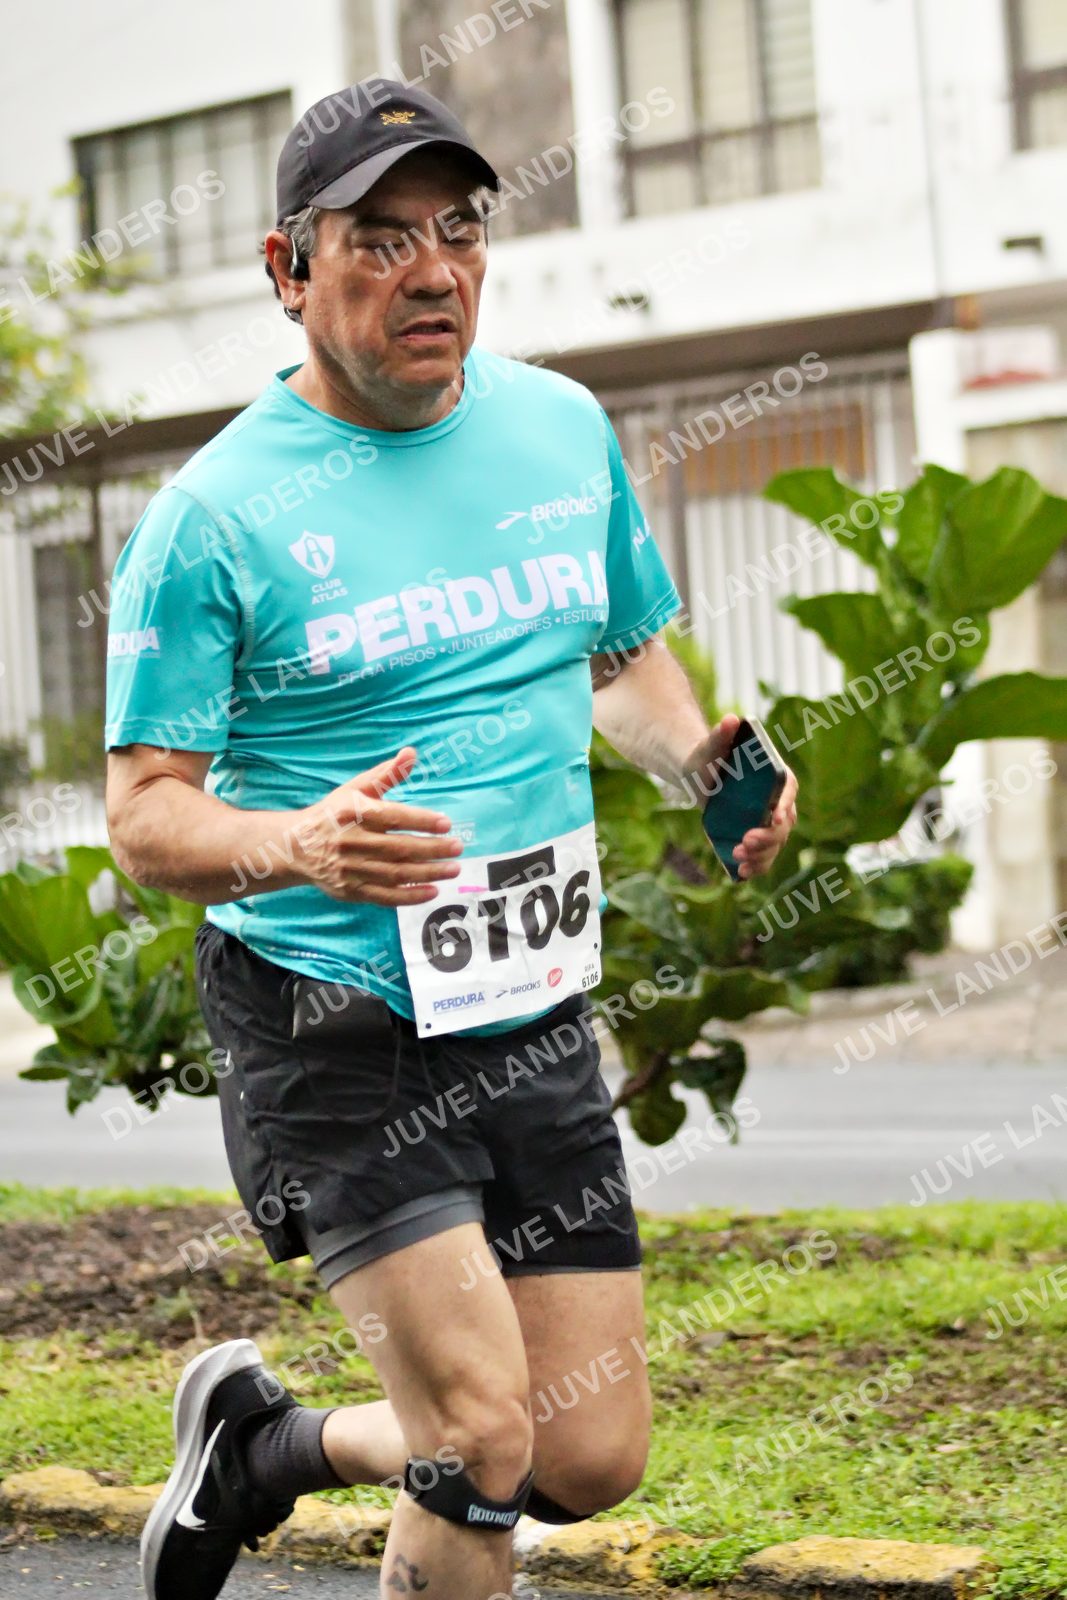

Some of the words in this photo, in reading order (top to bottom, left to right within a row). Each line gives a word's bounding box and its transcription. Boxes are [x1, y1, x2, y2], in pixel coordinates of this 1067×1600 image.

[531, 496, 598, 522] BROOKS
[312, 578, 343, 594] CLUB
[312, 587, 349, 605] ATLAS
[389, 646, 437, 671] PISOS
[447, 616, 552, 655] JUNTEADORES
[421, 870, 591, 974] 6106
[581, 971, 599, 988] 6106
[433, 991, 486, 1012] PERDURA
[510, 980, 541, 996] BROOKS
